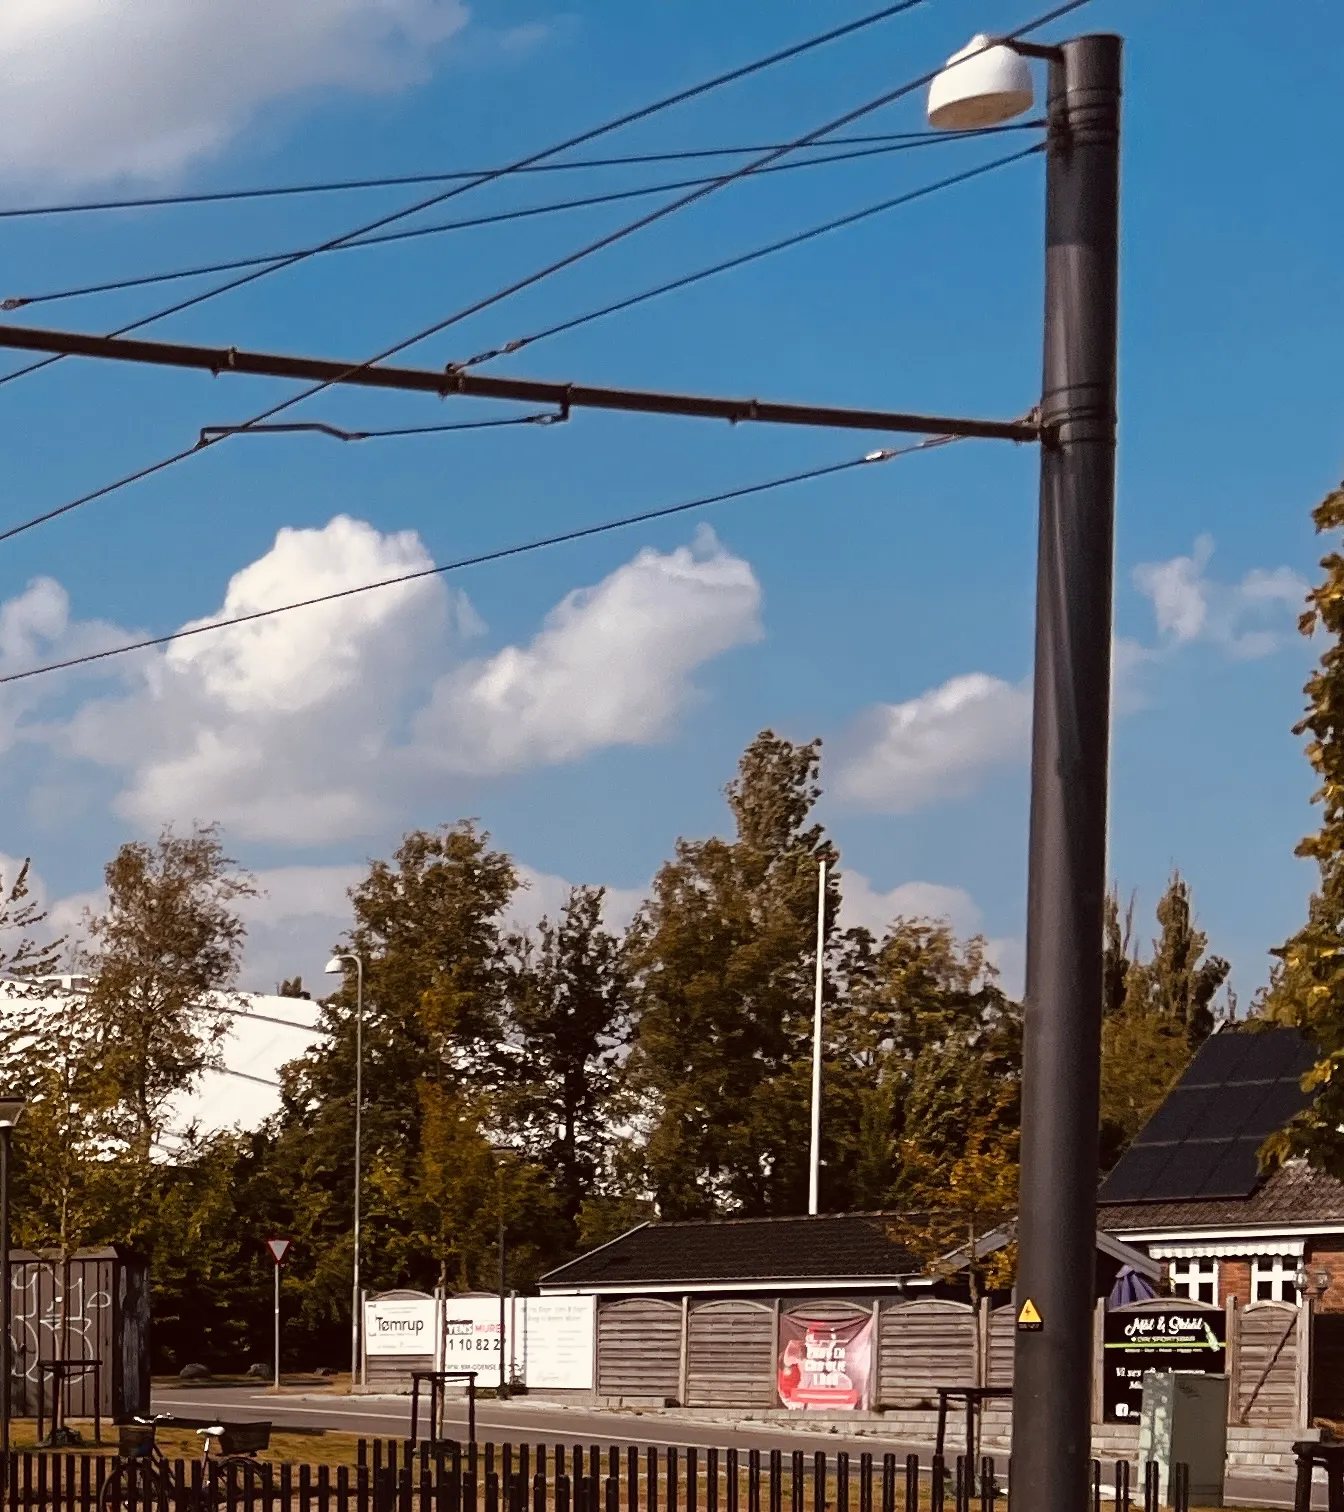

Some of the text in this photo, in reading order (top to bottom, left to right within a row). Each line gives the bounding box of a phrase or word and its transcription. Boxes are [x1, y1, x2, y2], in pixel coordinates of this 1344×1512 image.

[475, 1323, 506, 1333] MURE
[459, 1338, 472, 1351] 10
[476, 1338, 489, 1351] 82
